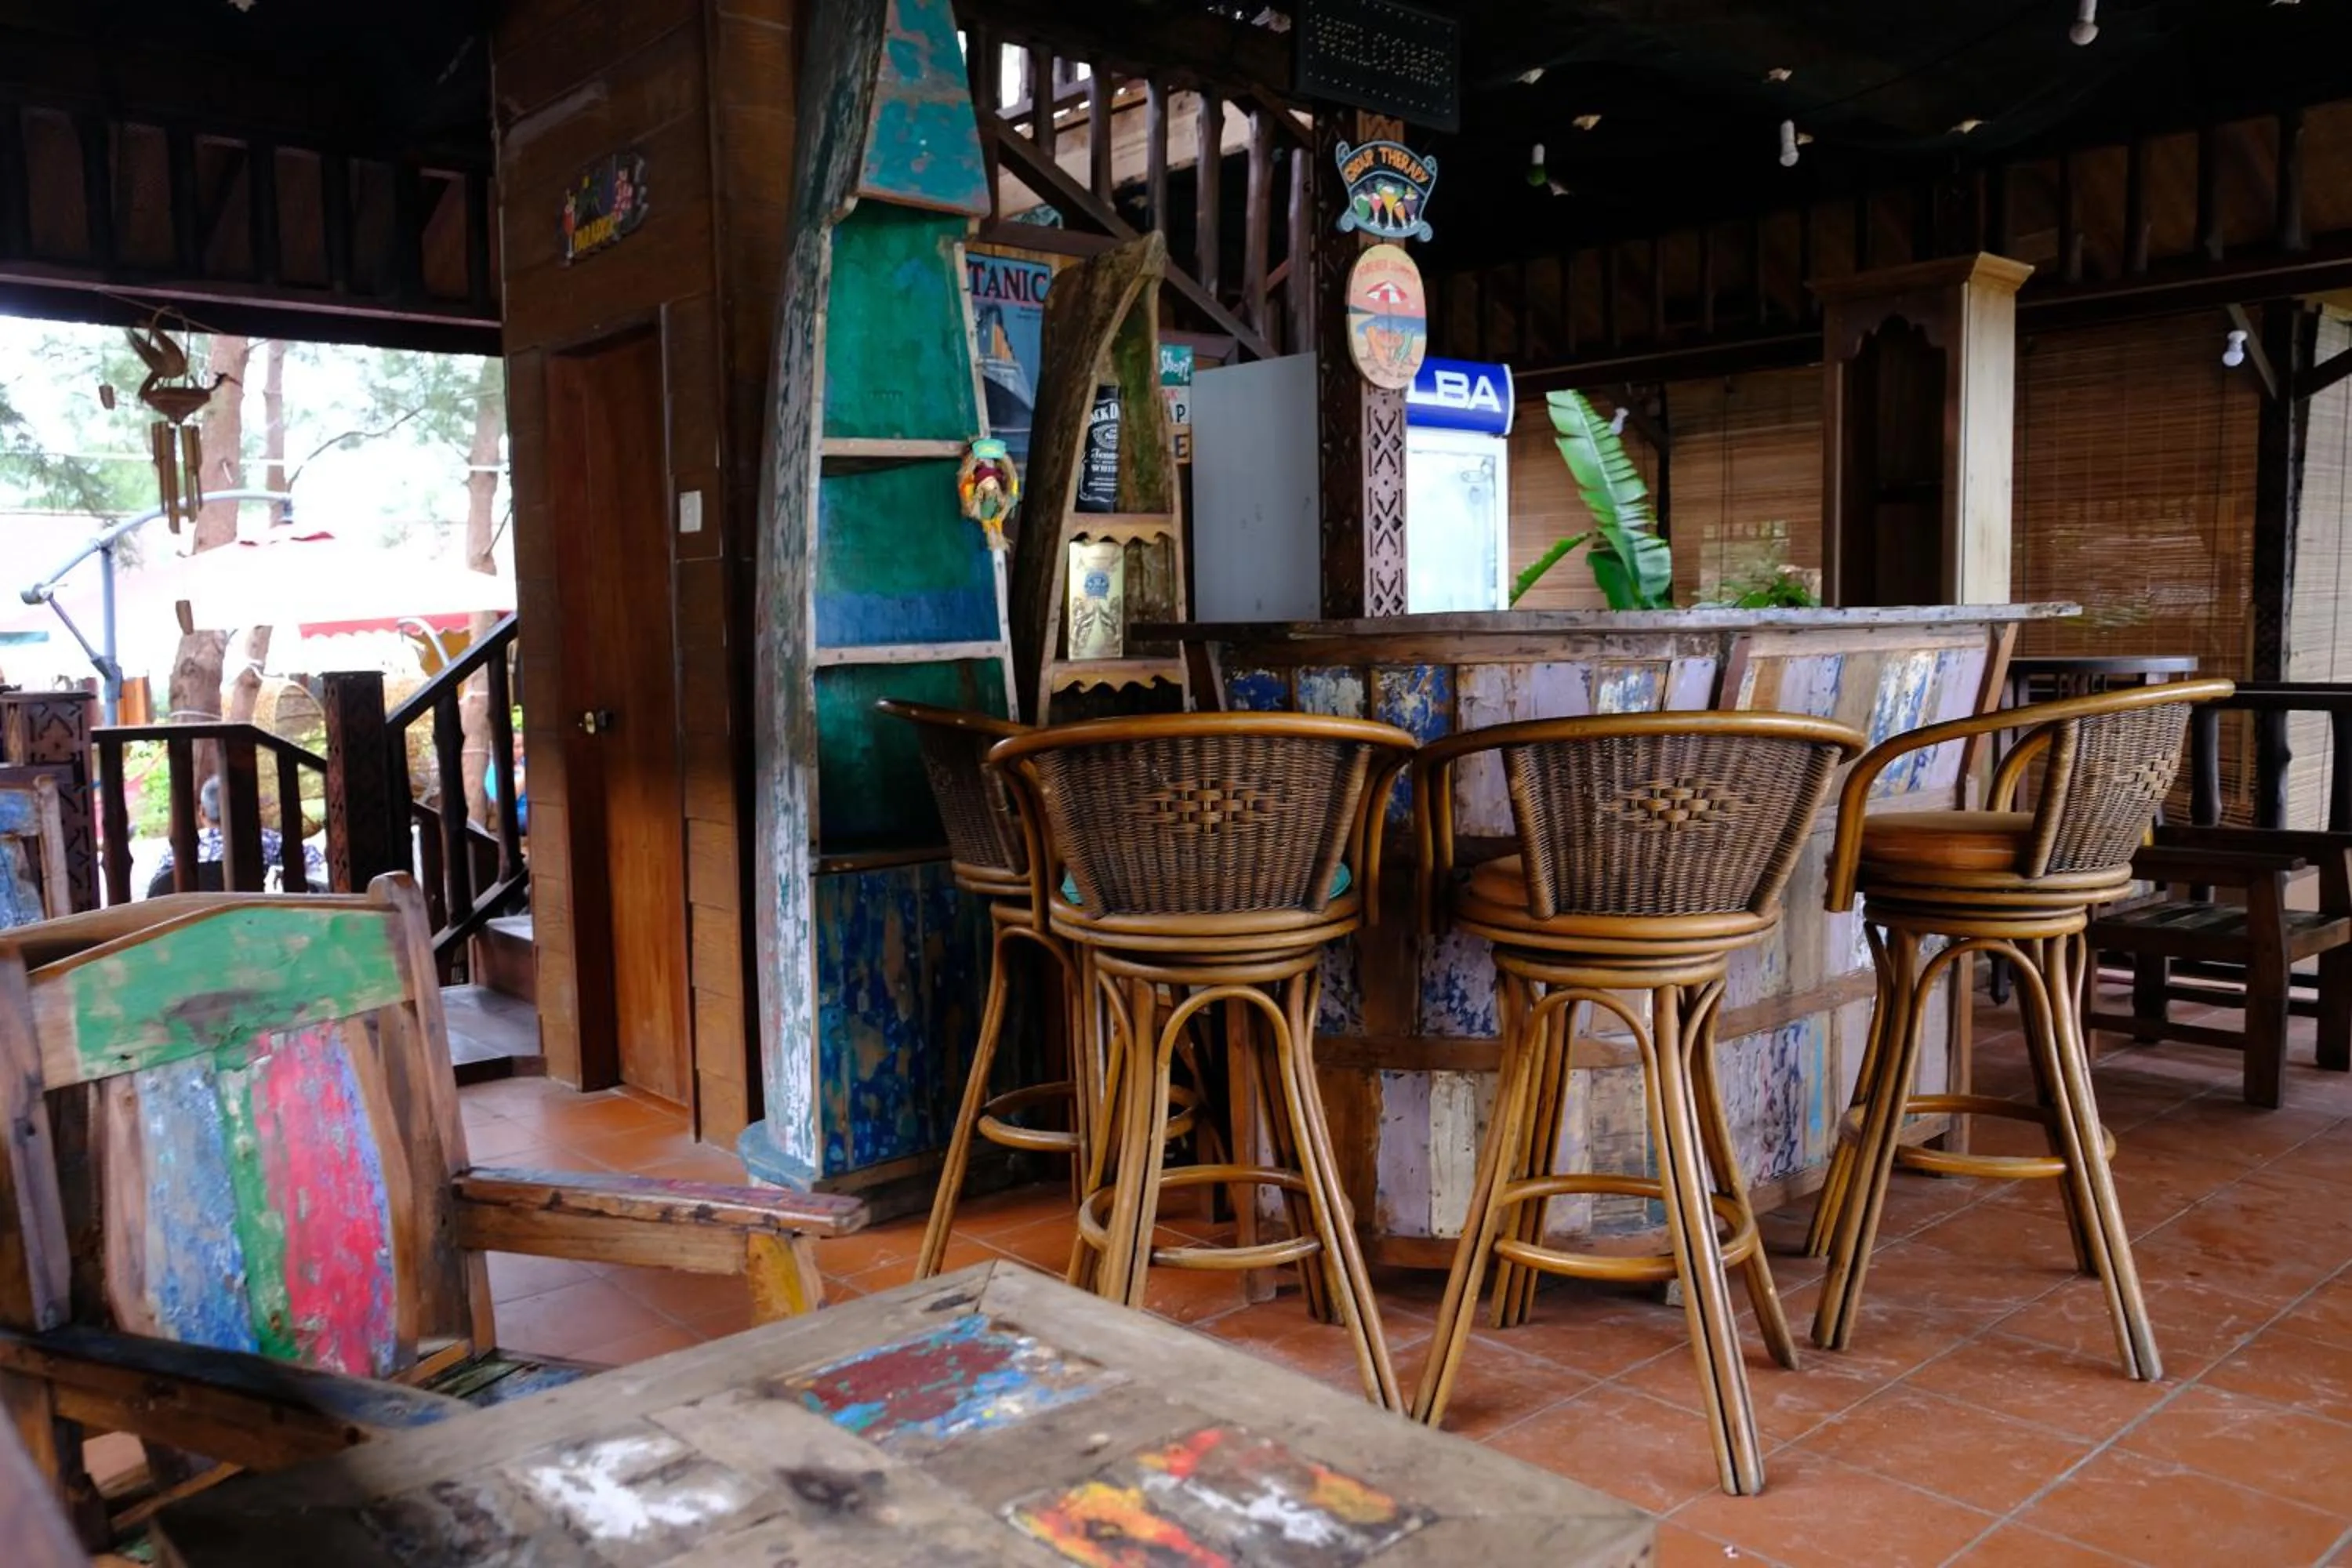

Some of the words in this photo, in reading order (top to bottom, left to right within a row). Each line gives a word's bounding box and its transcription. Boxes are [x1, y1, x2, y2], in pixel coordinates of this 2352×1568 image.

[1315, 13, 1445, 87] WELCOME
[1378, 147, 1429, 183] THERAPY
[967, 260, 1048, 303] TANIC
[1405, 370, 1502, 413] LBA
